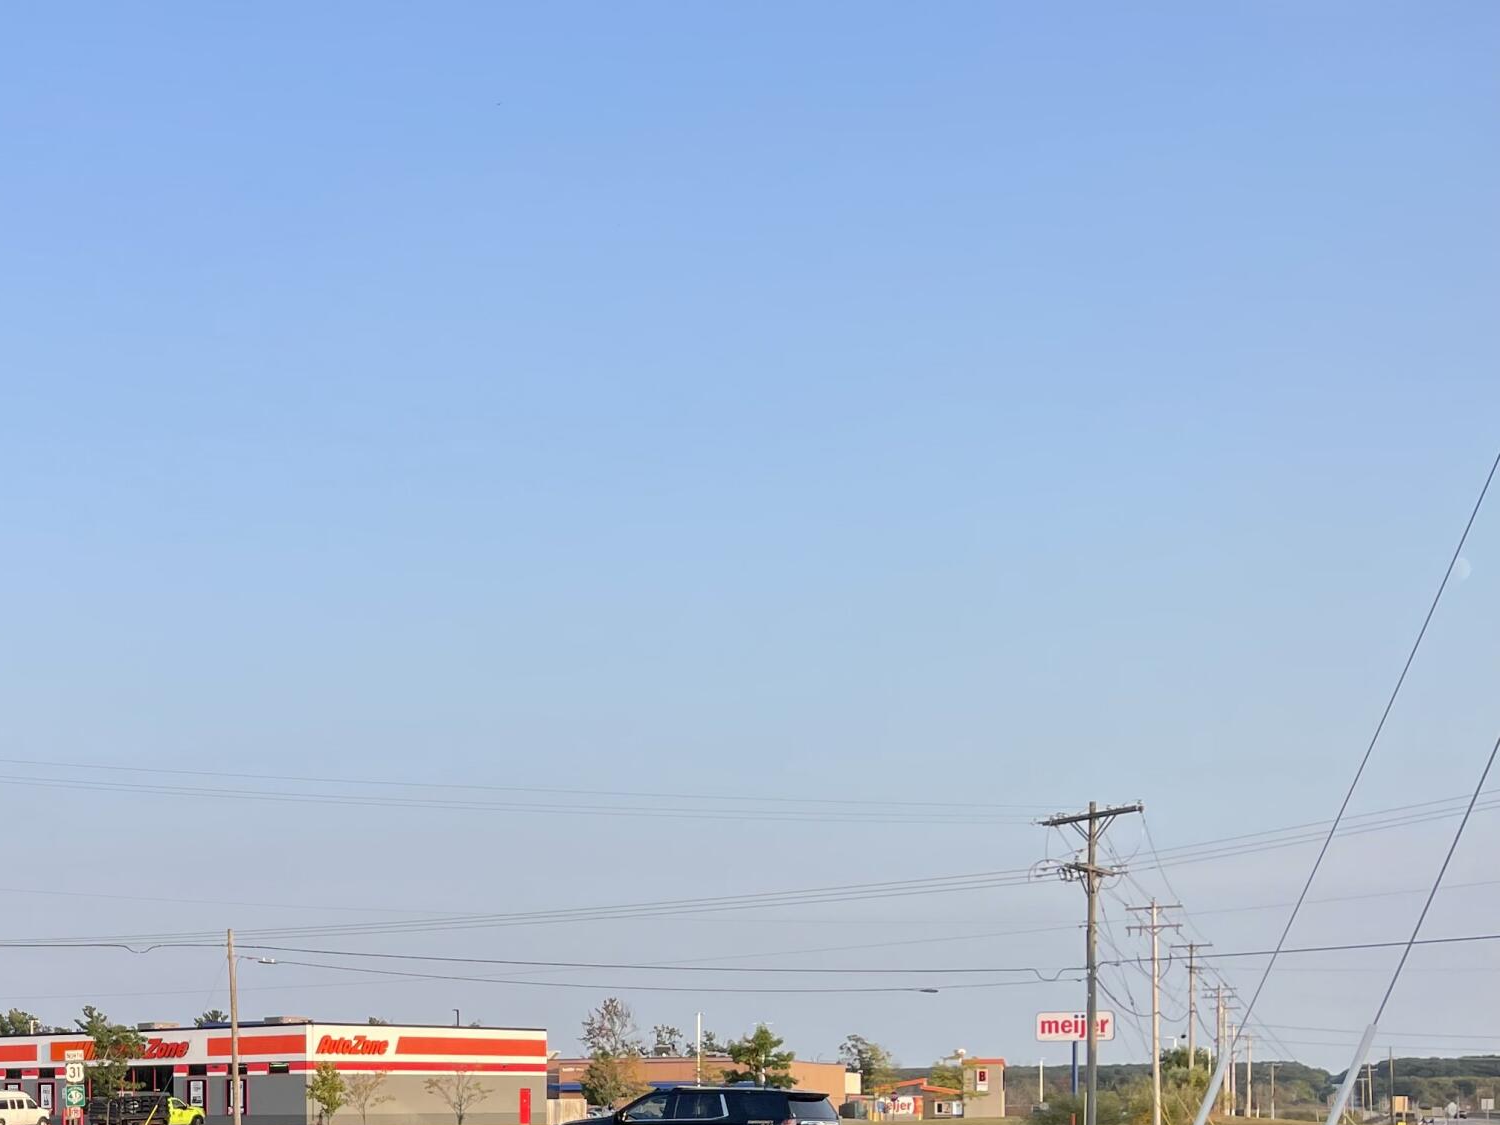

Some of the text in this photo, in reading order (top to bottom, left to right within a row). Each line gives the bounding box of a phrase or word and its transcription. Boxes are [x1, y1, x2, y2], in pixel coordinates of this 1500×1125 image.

[315, 1035, 389, 1055] AutoZone
[69, 1066, 81, 1079] 31
[881, 1099, 912, 1113] eijer
